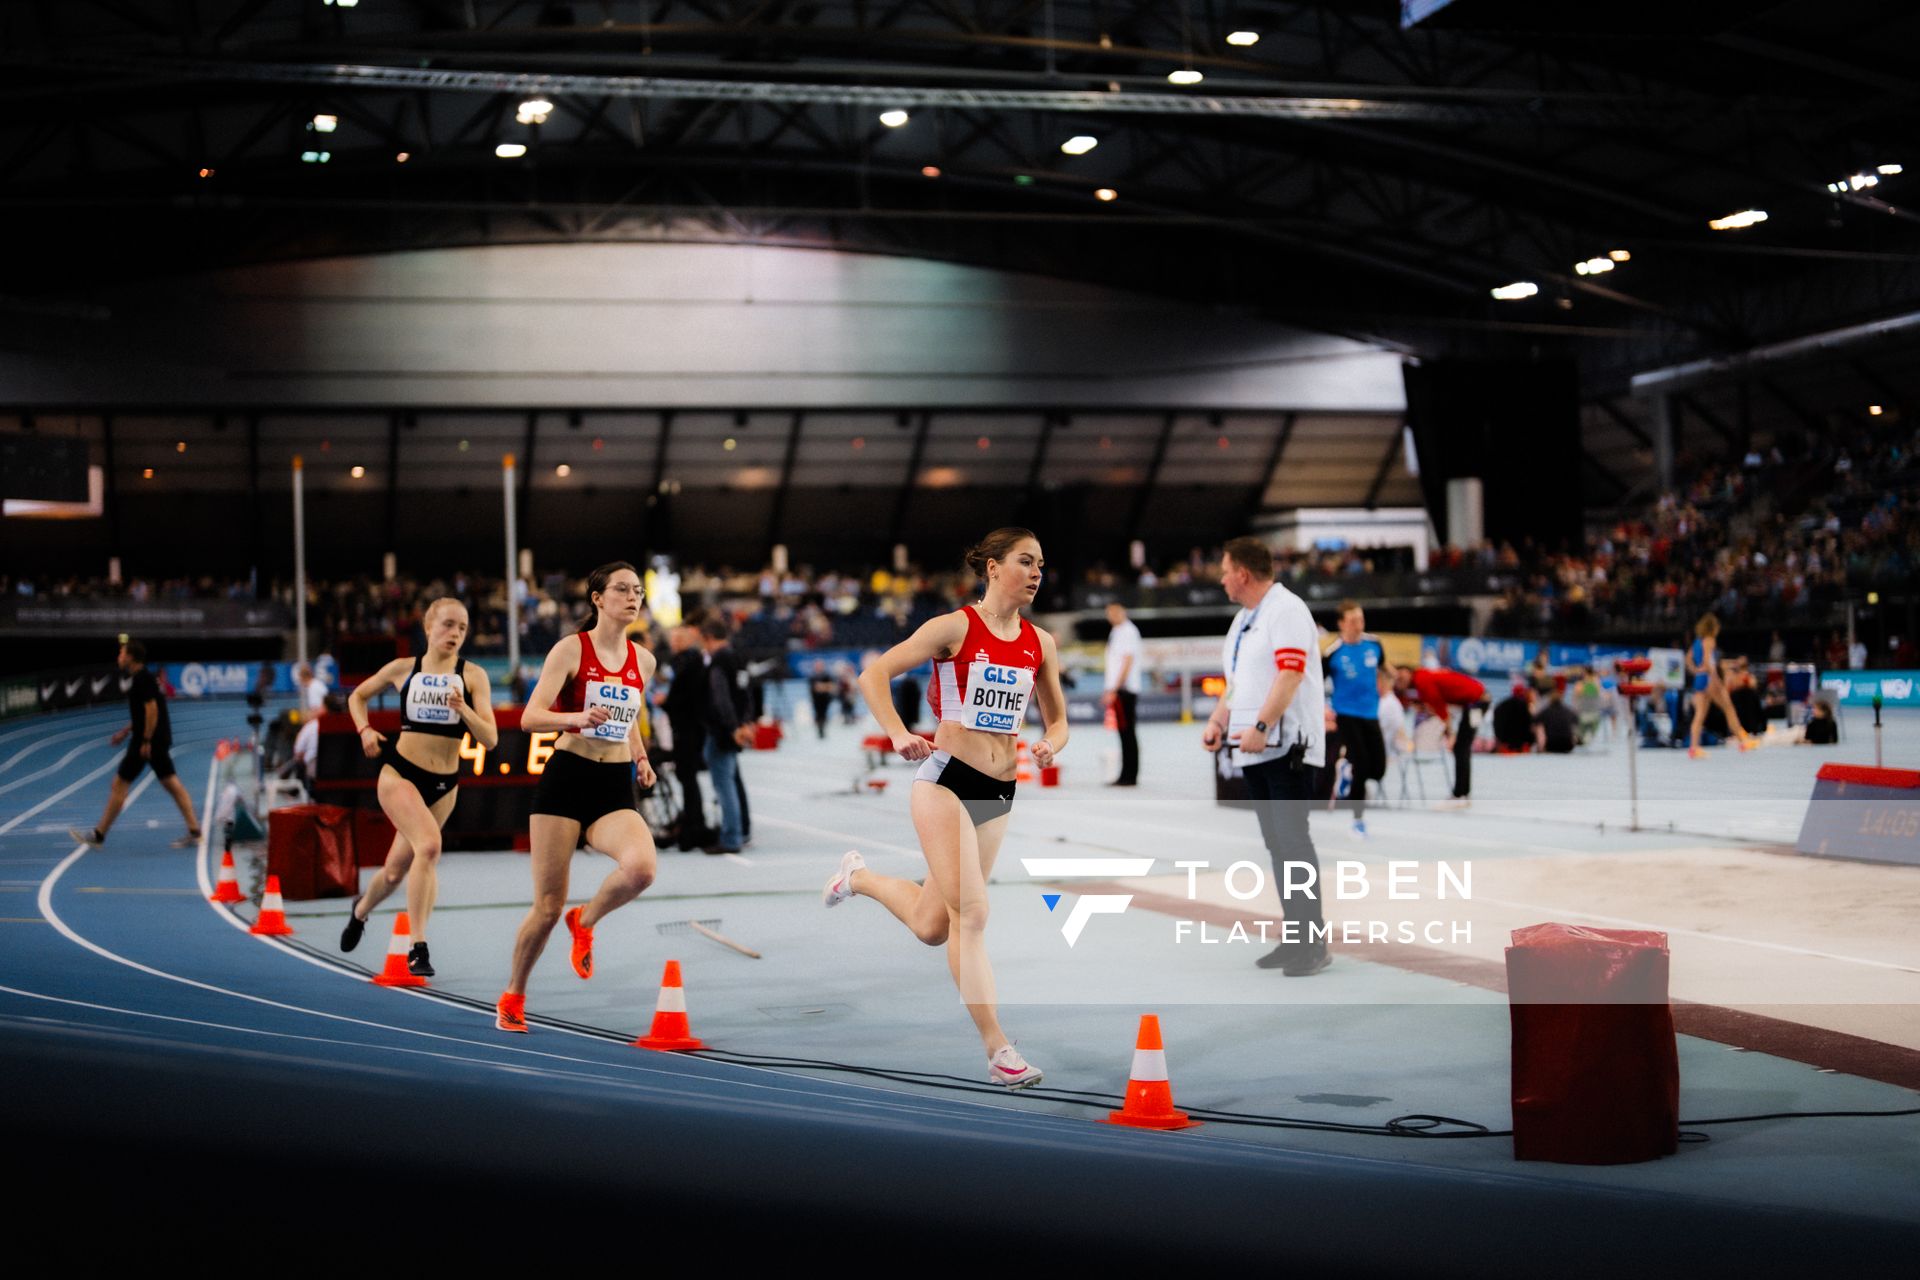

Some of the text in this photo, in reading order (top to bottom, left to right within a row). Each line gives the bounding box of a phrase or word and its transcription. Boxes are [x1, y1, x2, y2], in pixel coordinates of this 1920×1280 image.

[422, 676, 448, 687] GLS
[983, 666, 1018, 685] GLS
[599, 685, 630, 701] GLS
[973, 687, 1024, 711] BOTHE
[992, 715, 1013, 725] PLAN
